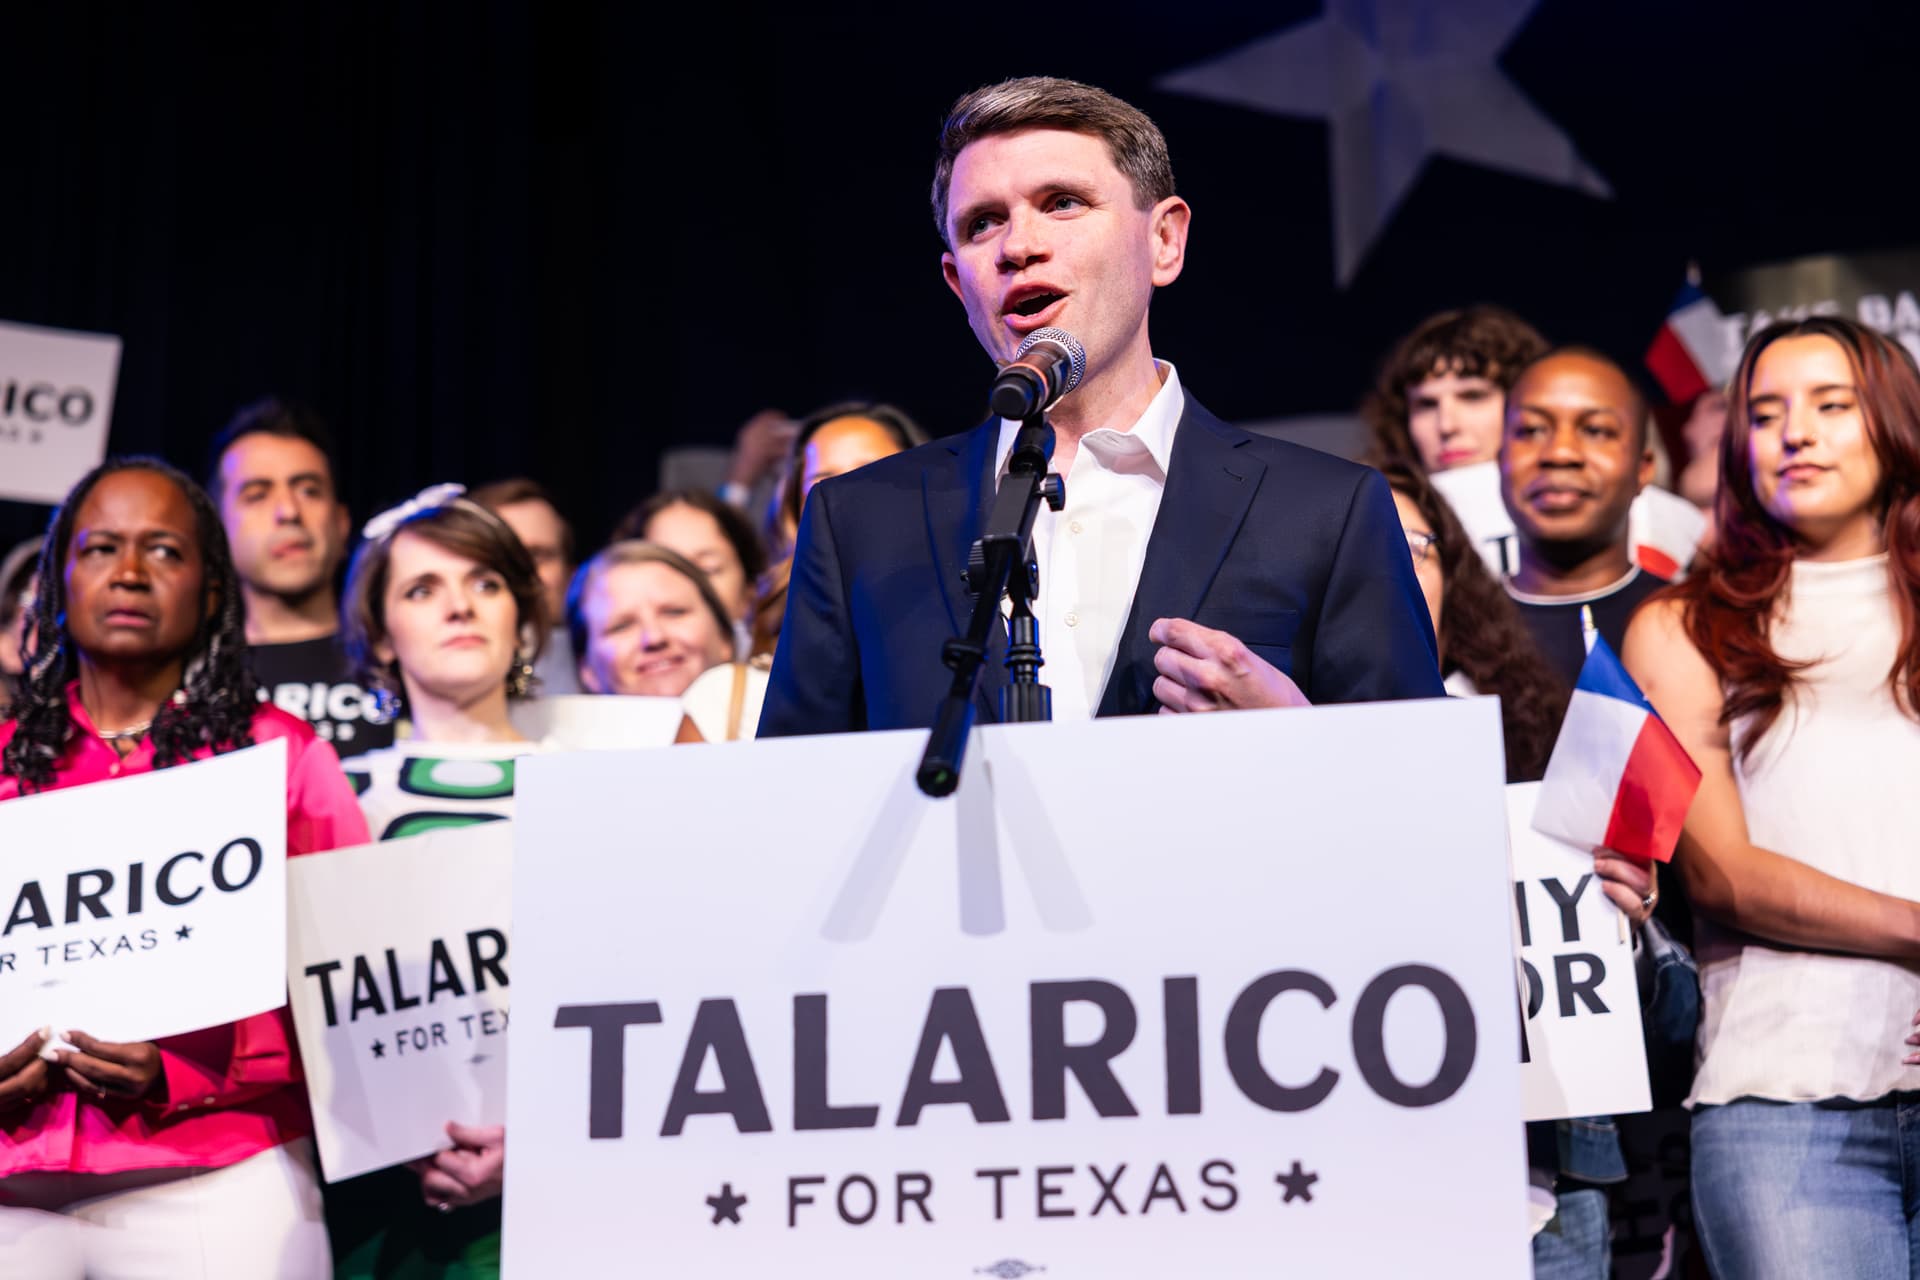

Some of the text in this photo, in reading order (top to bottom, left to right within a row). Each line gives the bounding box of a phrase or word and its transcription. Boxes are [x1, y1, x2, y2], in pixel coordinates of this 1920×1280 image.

[0, 380, 94, 427] ICO
[256, 683, 396, 724] RIC
[2, 837, 262, 936] ARICO
[37, 929, 157, 965] TEXAS
[305, 928, 509, 1027] TALAR
[396, 1023, 447, 1056] FOR
[553, 963, 1477, 1139] TALARICO
[788, 1160, 1239, 1227] FOR TEXAS
